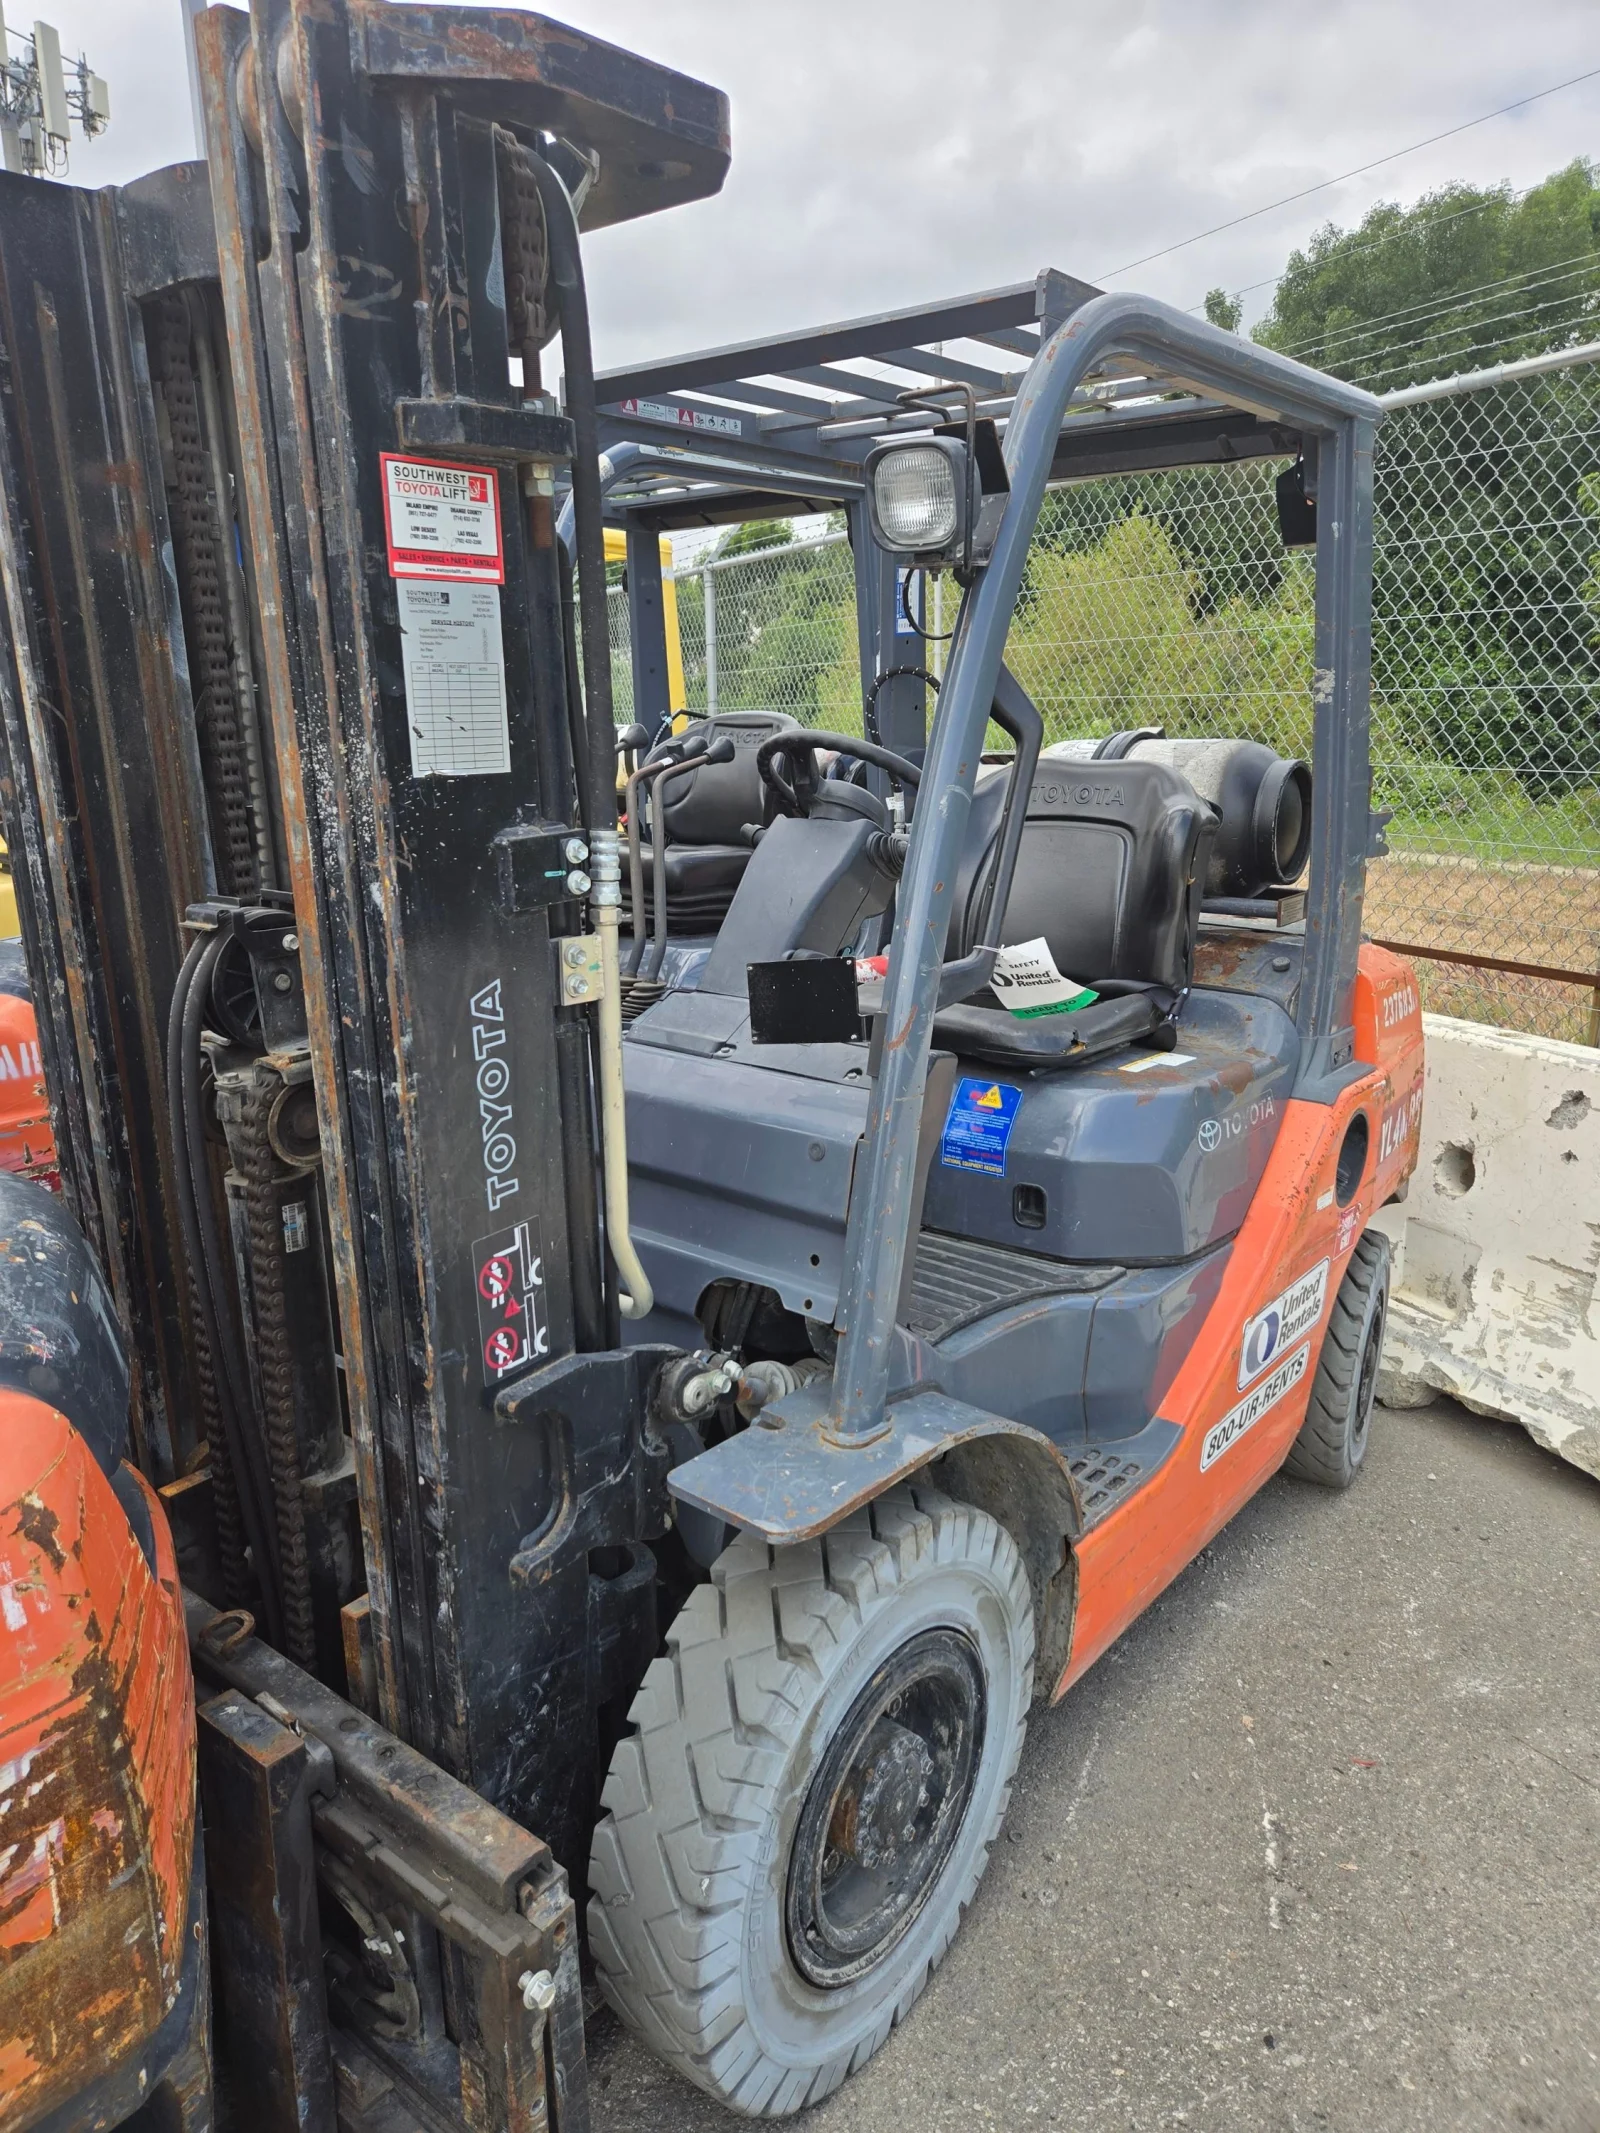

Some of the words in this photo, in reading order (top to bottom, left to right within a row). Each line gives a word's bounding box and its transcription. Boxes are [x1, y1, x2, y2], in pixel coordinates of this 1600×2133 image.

[394, 465, 467, 485] SOUTHWEST
[395, 481, 468, 500] TOYOTALIFT
[421, 554, 445, 562] SERVICE
[473, 559, 496, 567] RENTALS
[406, 590, 440, 598] SOUTHWEST
[1031, 783, 1125, 806] TOYOTA
[1009, 959, 1040, 969] SAFETY
[1010, 971, 1051, 981] United
[1016, 977, 1061, 987] Rentals
[1024, 1002, 1060, 1015] READY
[1061, 999, 1077, 1008] TO
[470, 978, 519, 1211] TOYOTA
[944, 1157, 961, 1165] NATIONAL
[962, 1160, 983, 1169] EQUIPMENT
[984, 1163, 1002, 1173] REGISTER
[1281, 1269, 1323, 1321] United
[1278, 1297, 1321, 1348] Rentals
[1207, 1351, 1304, 1460] 800-UR-RENTS
